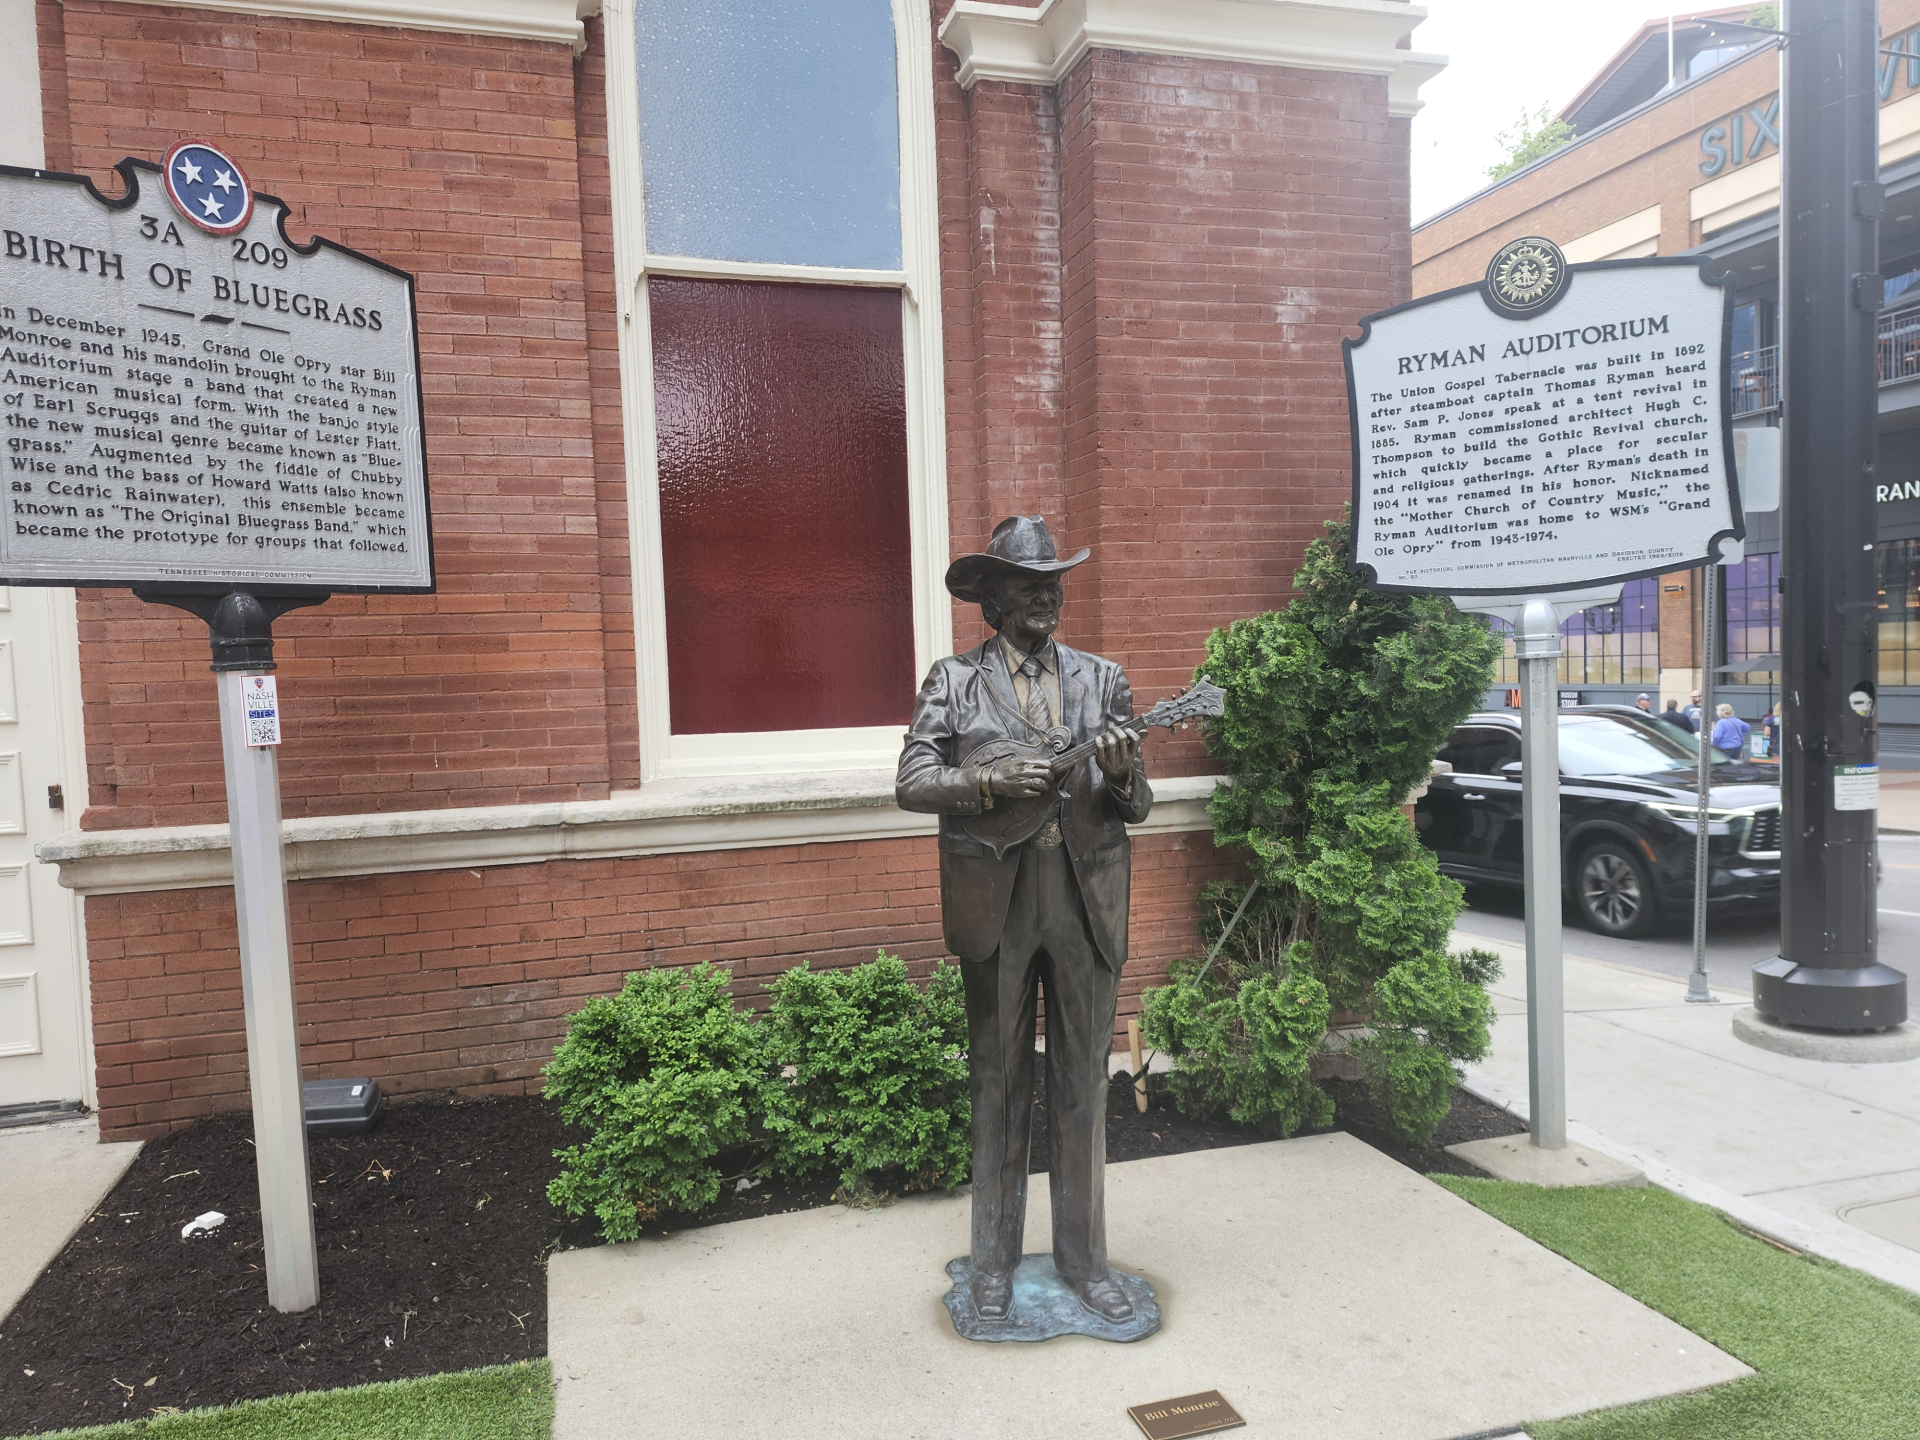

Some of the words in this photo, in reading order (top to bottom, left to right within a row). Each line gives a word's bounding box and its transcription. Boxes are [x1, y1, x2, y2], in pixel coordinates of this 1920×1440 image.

[1700, 96, 1779, 176] SIX
[140, 214, 184, 246] 3A
[232, 238, 288, 269] 209
[3, 229, 125, 280] BIRTH
[150, 262, 192, 292] OF
[213, 275, 383, 331] BLUEGRASS
[0, 324, 72, 351] Monroe
[79, 341, 114, 357] and
[121, 344, 148, 362] his
[153, 353, 229, 374] mandolin
[234, 362, 296, 386] brought
[302, 374, 317, 387] to
[321, 378, 345, 392] the
[350, 381, 397, 400] Ryman
[1398, 343, 1487, 375] RYMAN
[1501, 315, 1670, 359] AUDITORIUM
[0, 346, 113, 378] Auditorium
[126, 368, 172, 388] stage
[184, 377, 194, 389] a
[205, 377, 246, 396] band
[253, 385, 284, 401] that
[294, 393, 350, 411] created
[357, 403, 365, 413] a
[372, 404, 398, 417] new
[1370, 392, 1393, 403] The
[1400, 386, 1436, 398] Union
[1444, 376, 1486, 391] Gospel
[1494, 365, 1566, 384] Tabernacle
[1574, 362, 1598, 372] was
[1606, 352, 1642, 368] built
[1650, 350, 1665, 361] in
[1675, 343, 1706, 357] 1892
[1370, 407, 1402, 419] after
[1409, 394, 1475, 413] steamboat
[1483, 386, 1534, 402] captain
[1544, 378, 1596, 393] Thomas
[1606, 370, 1655, 385] Ryman
[1665, 359, 1707, 376] heard
[1, 368, 99, 395] American
[113, 387, 182, 406] musical
[193, 395, 236, 413] form.
[243, 401, 279, 419] With
[286, 408, 310, 423] the
[318, 412, 359, 430] banjo
[367, 421, 399, 435] style
[2, 392, 24, 408] of
[33, 393, 75, 413] Earl
[86, 401, 160, 425] Scruggs
[170, 414, 200, 428] and
[207, 416, 234, 432] the
[240, 422, 288, 438] guitar
[294, 427, 309, 441] of
[315, 429, 360, 447] Lester
[1371, 424, 1396, 434] Rev.
[1403, 419, 1429, 429] Sam
[1437, 414, 1450, 425] P.
[1457, 409, 1494, 422] Jones
[1504, 400, 1542, 417] speak
[1551, 397, 1566, 409] at
[1576, 397, 1584, 405] a
[1593, 389, 1623, 403] tent
[1633, 380, 1683, 397] revival
[1692, 378, 1708, 389] in
[1371, 437, 1400, 450] 1885.
[1413, 431, 1457, 444] Ryman
[1468, 414, 1559, 436] commissioned
[1568, 404, 1633, 423] architect
[1645, 398, 1681, 413] Hugh
[1692, 395, 1708, 406] C.
[1371, 450, 1433, 465] Thompson
[1441, 446, 1455, 456] to
[1463, 439, 1497, 453] build
[1506, 436, 1529, 447] the
[1538, 429, 1583, 443] Gothic
[1592, 420, 1645, 437] Revival
[1372, 467, 1407, 480] which
[1420, 460, 1469, 476] quickly
[1483, 453, 1532, 467] became
[1545, 450, 1553, 459] a
[1567, 444, 1603, 458] place
[1618, 439, 1640, 450] for
[1656, 430, 1708, 445] secular
[8, 456, 56, 474] Wise
[64, 463, 99, 479] and
[104, 465, 135, 480] the
[141, 467, 180, 484] bass
[186, 472, 205, 486] of
[211, 473, 272, 491] Howard
[278, 479, 318, 495] Watts
[323, 483, 357, 498] (also
[361, 487, 404, 503] known
[1372, 484, 1395, 496] and
[1401, 478, 1455, 492] religious
[1463, 469, 1535, 487] gatherings.
[1543, 463, 1580, 476] After
[1587, 454, 1641, 471] Ryman's
[1648, 448, 1689, 463] death
[1694, 447, 1709, 458] in
[1373, 498, 1400, 511] 1904
[1407, 496, 1418, 507] it
[1426, 495, 1448, 504] was
[1457, 485, 1512, 501] renamed
[1520, 484, 1534, 494] in
[1541, 480, 1562, 492] his
[1572, 476, 1616, 489] honor.
[1630, 463, 1710, 482] Nicknamed
[1876, 480, 1920, 502] RAN
[15, 520, 89, 538] became
[94, 525, 125, 540] the
[132, 529, 219, 546] prototype
[226, 531, 249, 546] for
[254, 536, 307, 550] groups
[312, 537, 343, 550] that
[348, 538, 408, 553] followed.
[1374, 546, 1395, 557] Ole
[1402, 540, 1444, 555] Opry"
[1450, 539, 1482, 550] from
[1490, 530, 1558, 546] 1943-1974.
[1457, 563, 1494, 571] COMMISSION
[1507, 558, 1554, 566] METROPOLITAN
[1558, 554, 1593, 562] NASHVILLE
[1612, 549, 1644, 557] DAVIDSON
[1648, 546, 1674, 554] COUNTY
[158, 568, 208, 576] TENNESSEE
[247, 691, 274, 700] NASH
[248, 700, 275, 709] VILLE
[249, 709, 275, 718] SITES
[1144, 1409, 1169, 1421] Bill
[1170, 1400, 1221, 1416] Monroe
